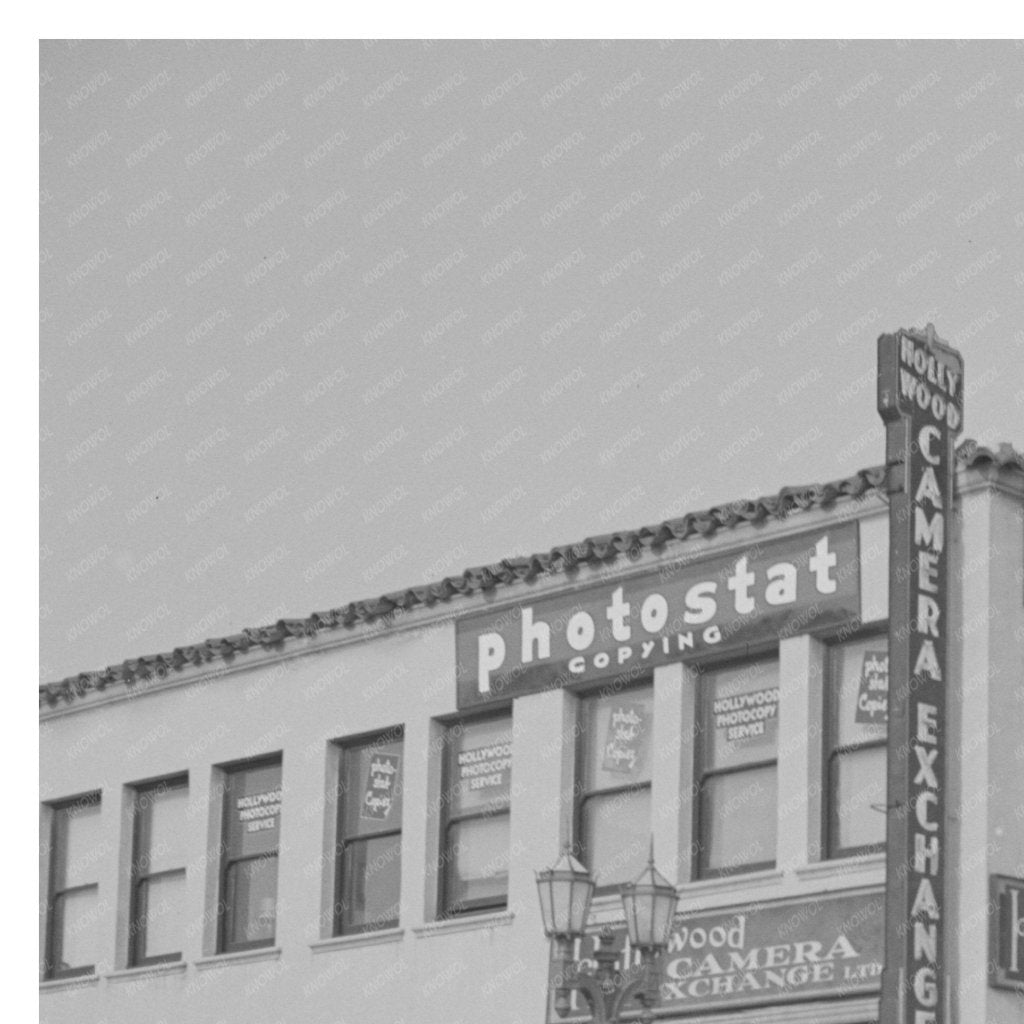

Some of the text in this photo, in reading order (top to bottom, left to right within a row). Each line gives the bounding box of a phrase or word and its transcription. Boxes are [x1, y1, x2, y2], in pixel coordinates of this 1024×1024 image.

[900, 334, 959, 398] HOLLY
[900, 368, 961, 431] WOOD
[914, 425, 945, 682] CAMERA
[478, 535, 837, 693] photostat
[568, 625, 722, 673] COPYING
[458, 741, 511, 766] HOLLYWOO
[727, 720, 766, 741] SERVICE
[667, 934, 860, 980] CAMERA
[661, 962, 834, 1001] XCHANGE
